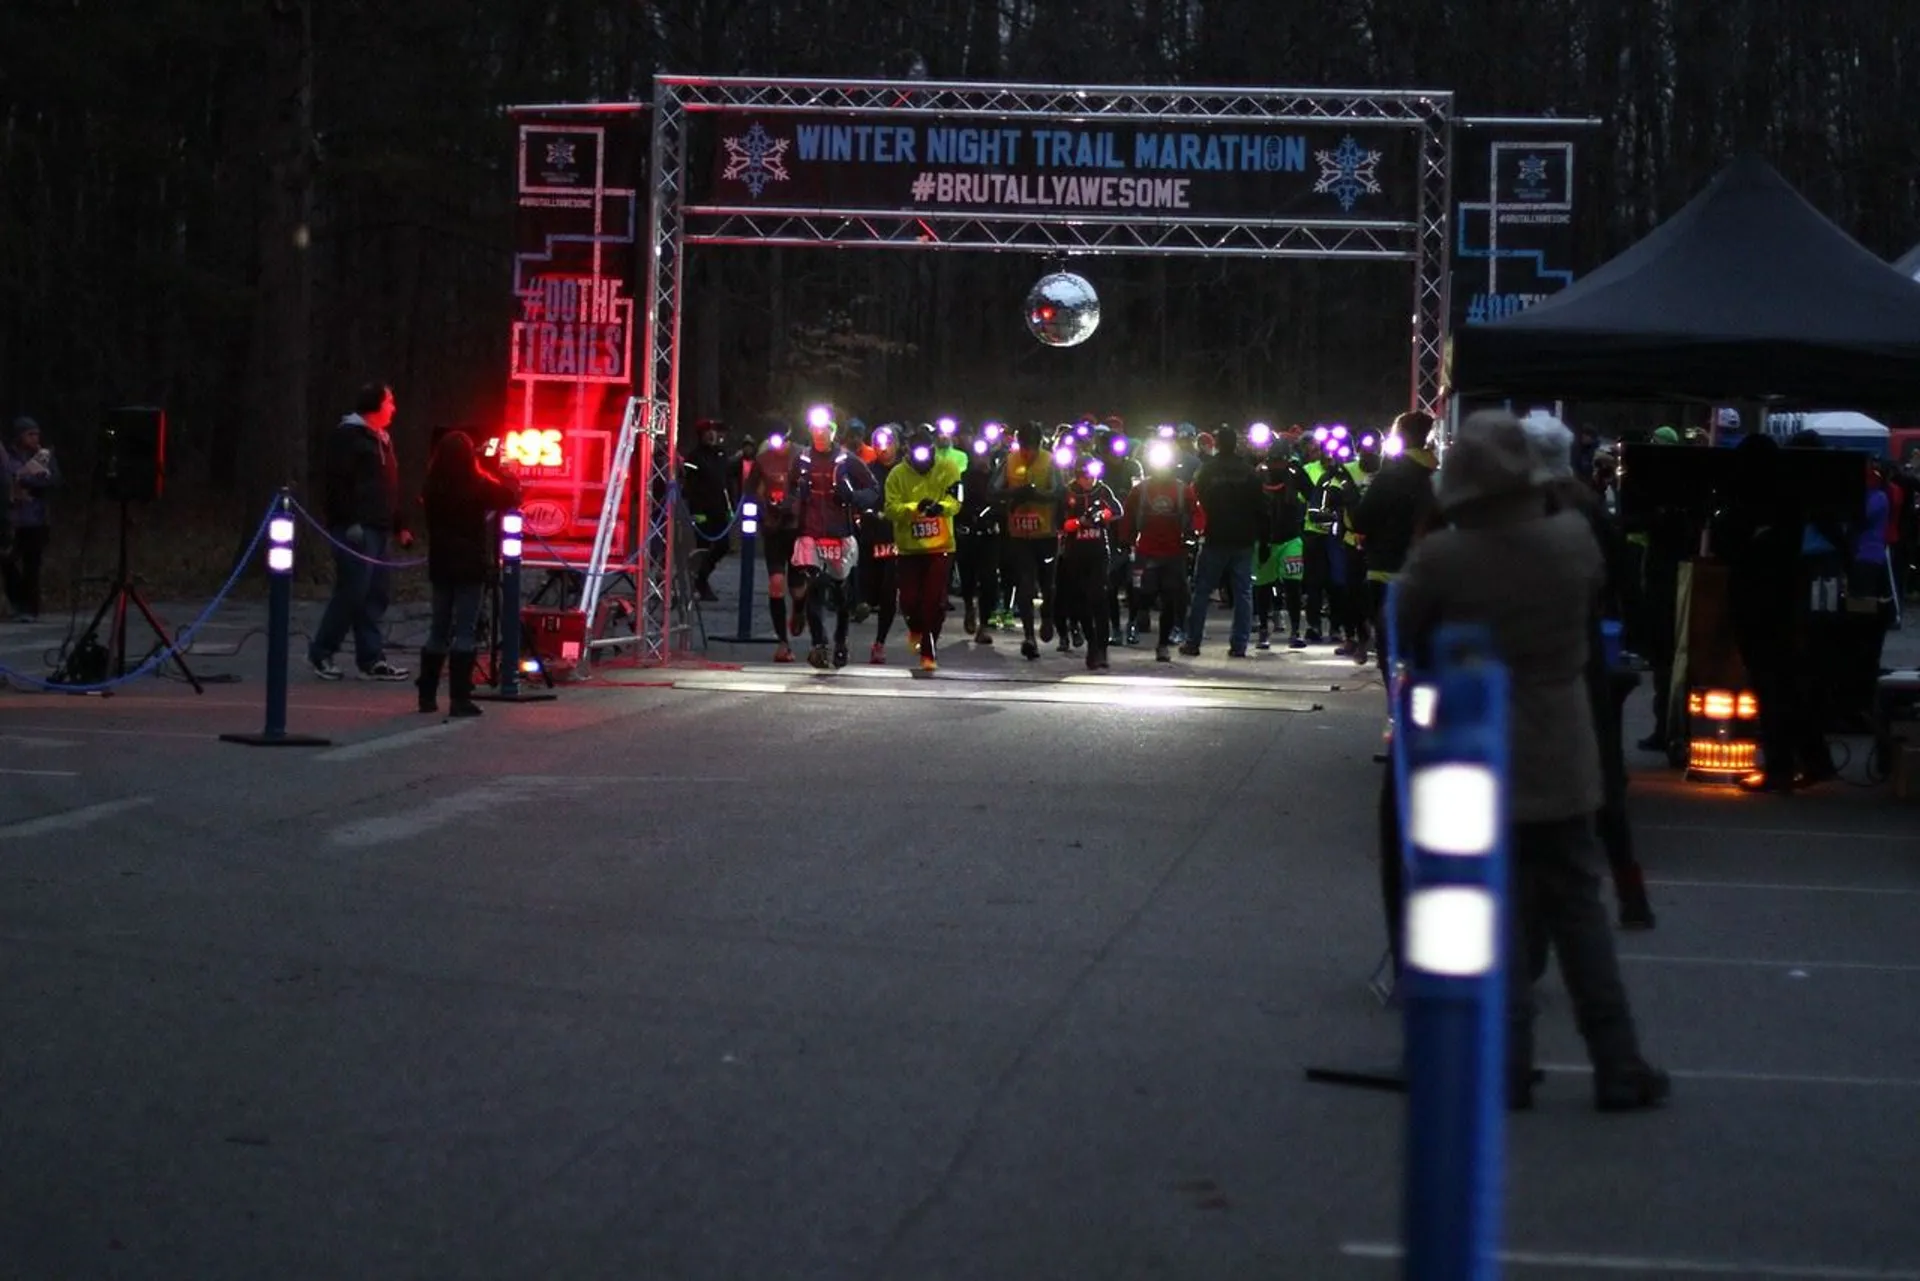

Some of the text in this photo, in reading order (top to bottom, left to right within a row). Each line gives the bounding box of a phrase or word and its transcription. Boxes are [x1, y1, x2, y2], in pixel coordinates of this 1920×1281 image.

[796, 124, 1307, 172] WINTER NIGHT TRAIL MARATHON
[910, 171, 1191, 209] #BRUTALLYAWESOME
[523, 323, 622, 376] TRAILS
[912, 521, 939, 537] 1396
